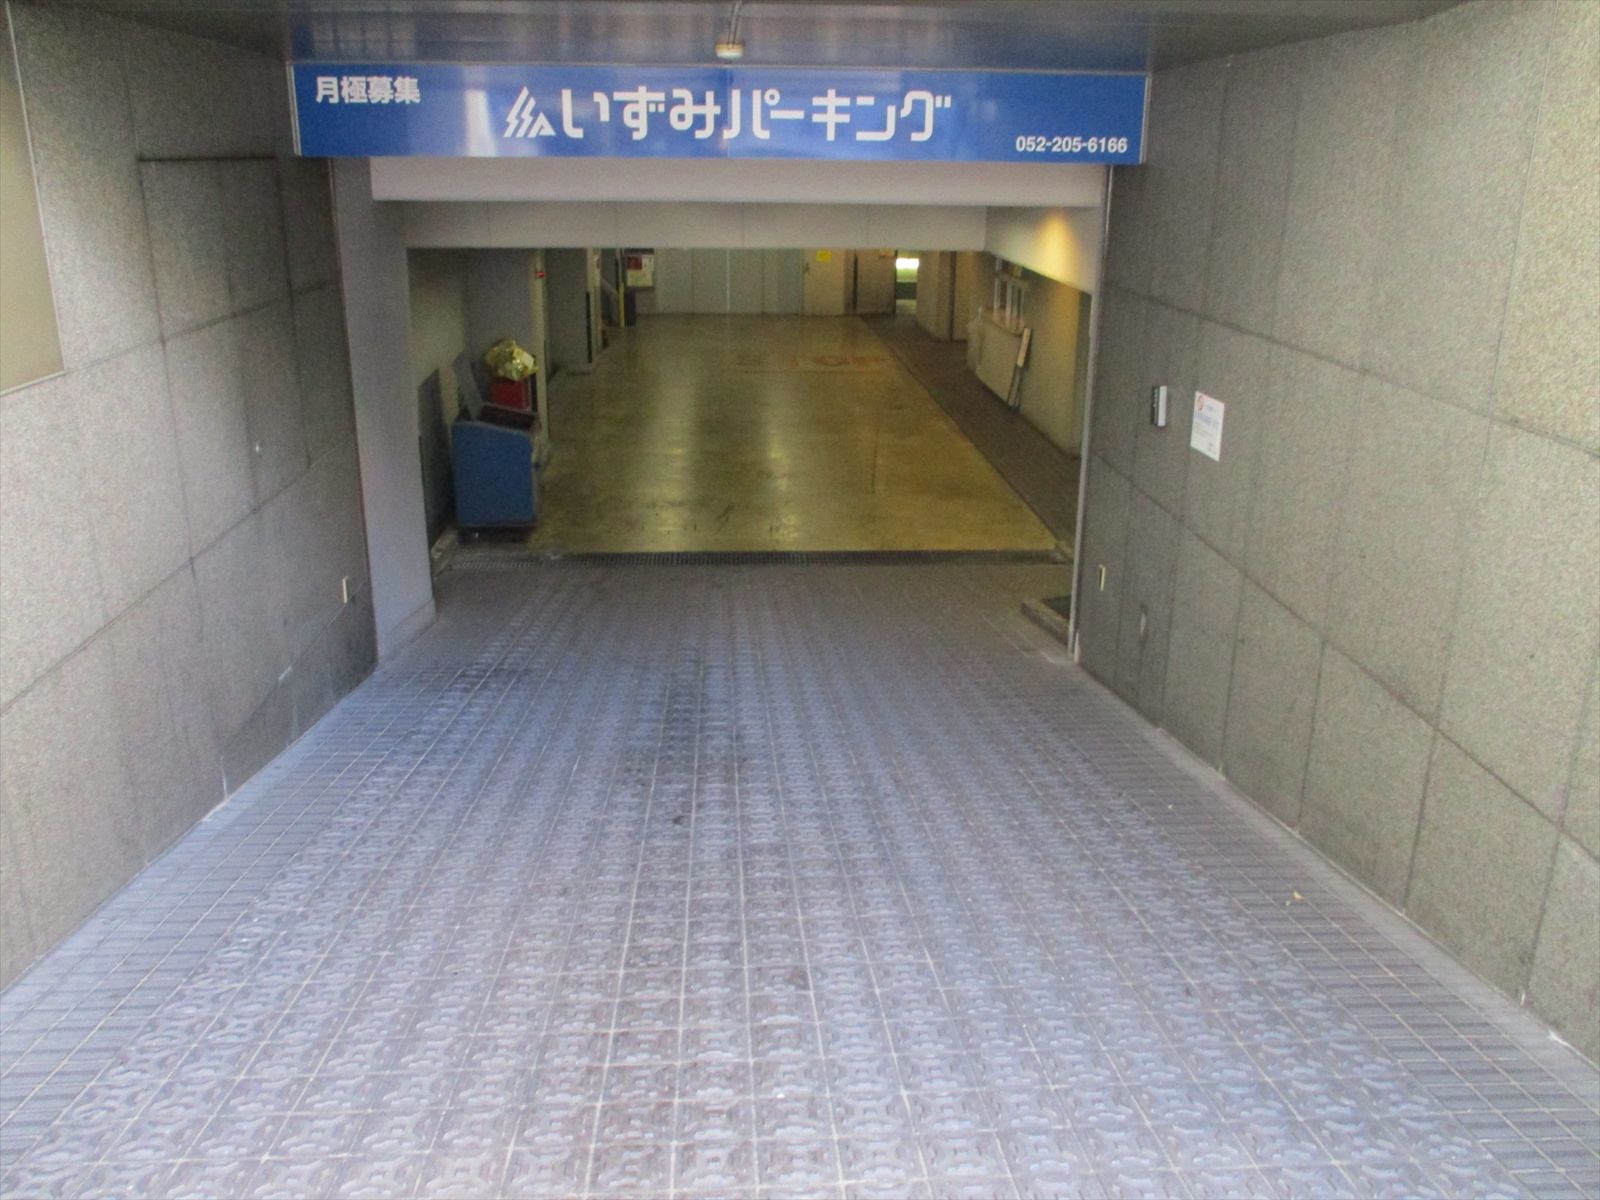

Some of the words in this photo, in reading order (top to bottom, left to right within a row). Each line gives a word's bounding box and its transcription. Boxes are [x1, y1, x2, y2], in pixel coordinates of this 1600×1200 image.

[315, 75, 421, 104] 月極募集
[561, 85, 952, 142] いずみパーキング
[1015, 134, 1128, 153] 052-205-6166
